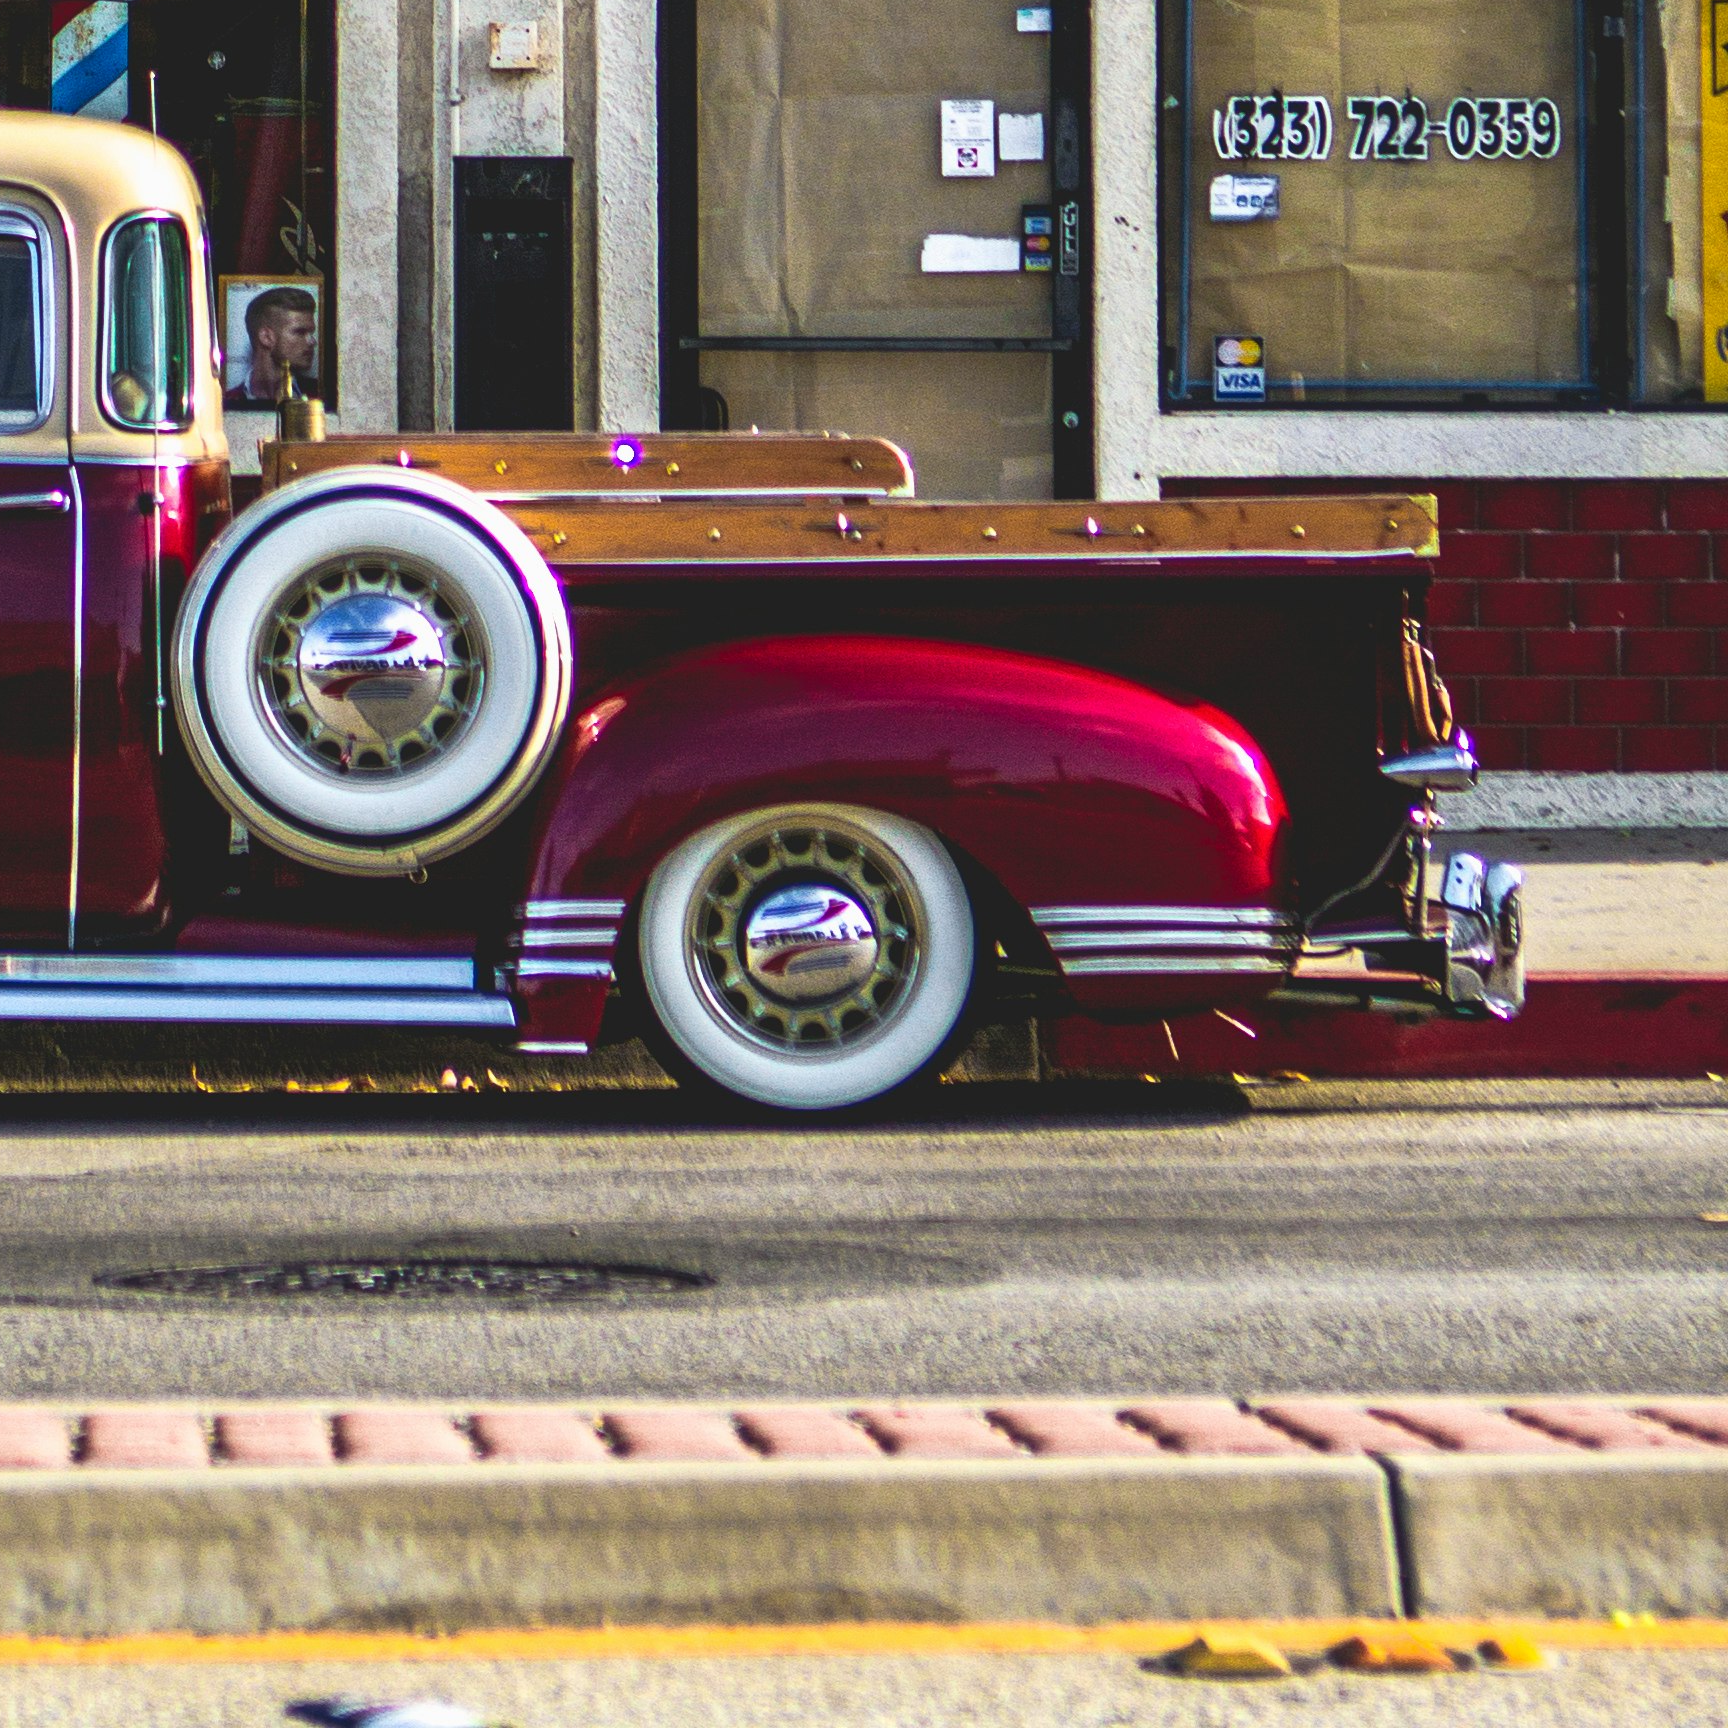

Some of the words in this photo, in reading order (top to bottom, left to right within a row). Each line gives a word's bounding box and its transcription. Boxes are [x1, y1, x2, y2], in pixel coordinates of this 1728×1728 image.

[1213, 96, 1332, 160] (323)
[1347, 96, 1561, 160] 722-0359
[1221, 373, 1261, 389] VISA
